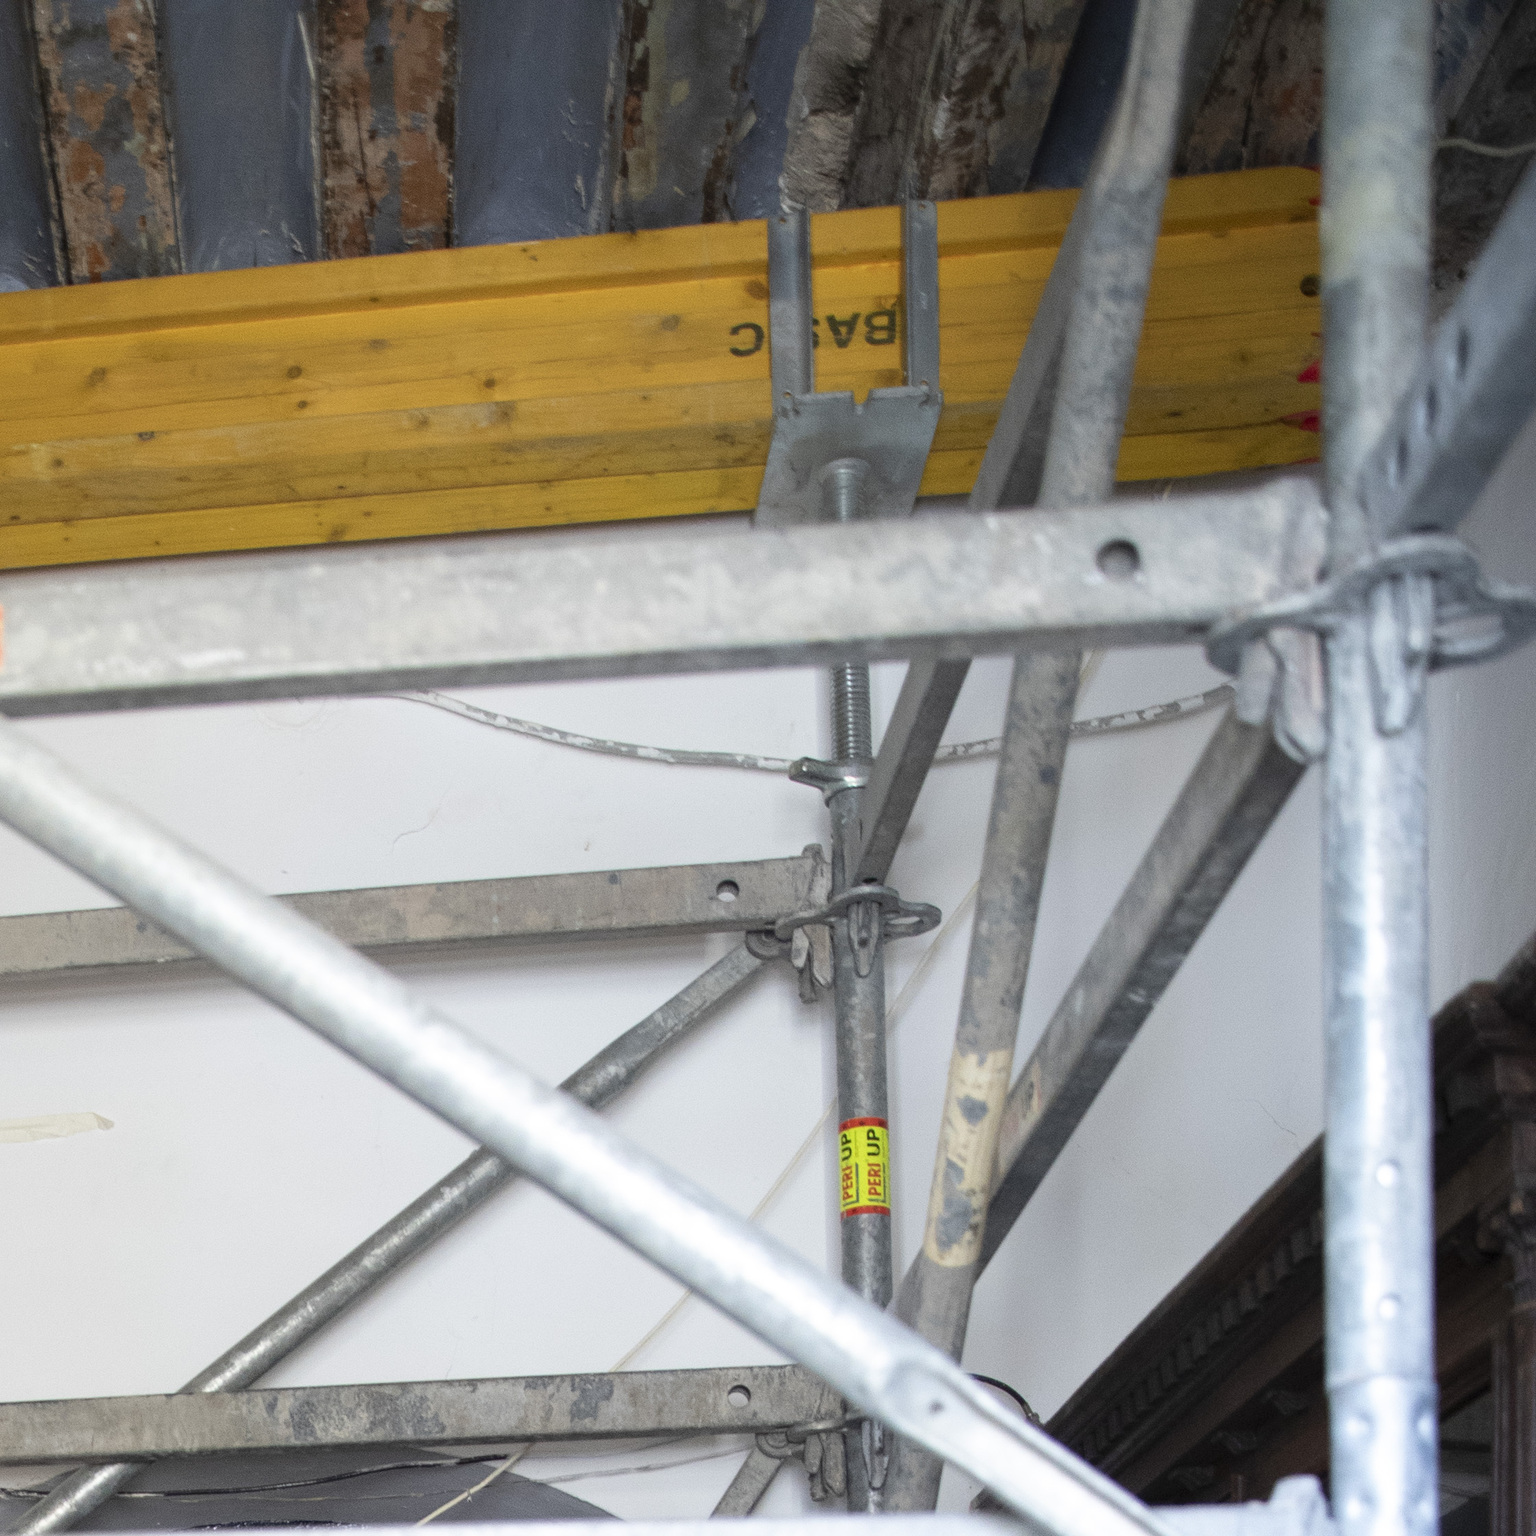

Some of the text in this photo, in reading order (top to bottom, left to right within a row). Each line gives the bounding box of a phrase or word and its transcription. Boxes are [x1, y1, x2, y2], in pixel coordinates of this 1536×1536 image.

[727, 308, 899, 358] BAC
[840, 1132, 854, 1202] PERI UP
[866, 1128, 882, 1197] PERI UP
